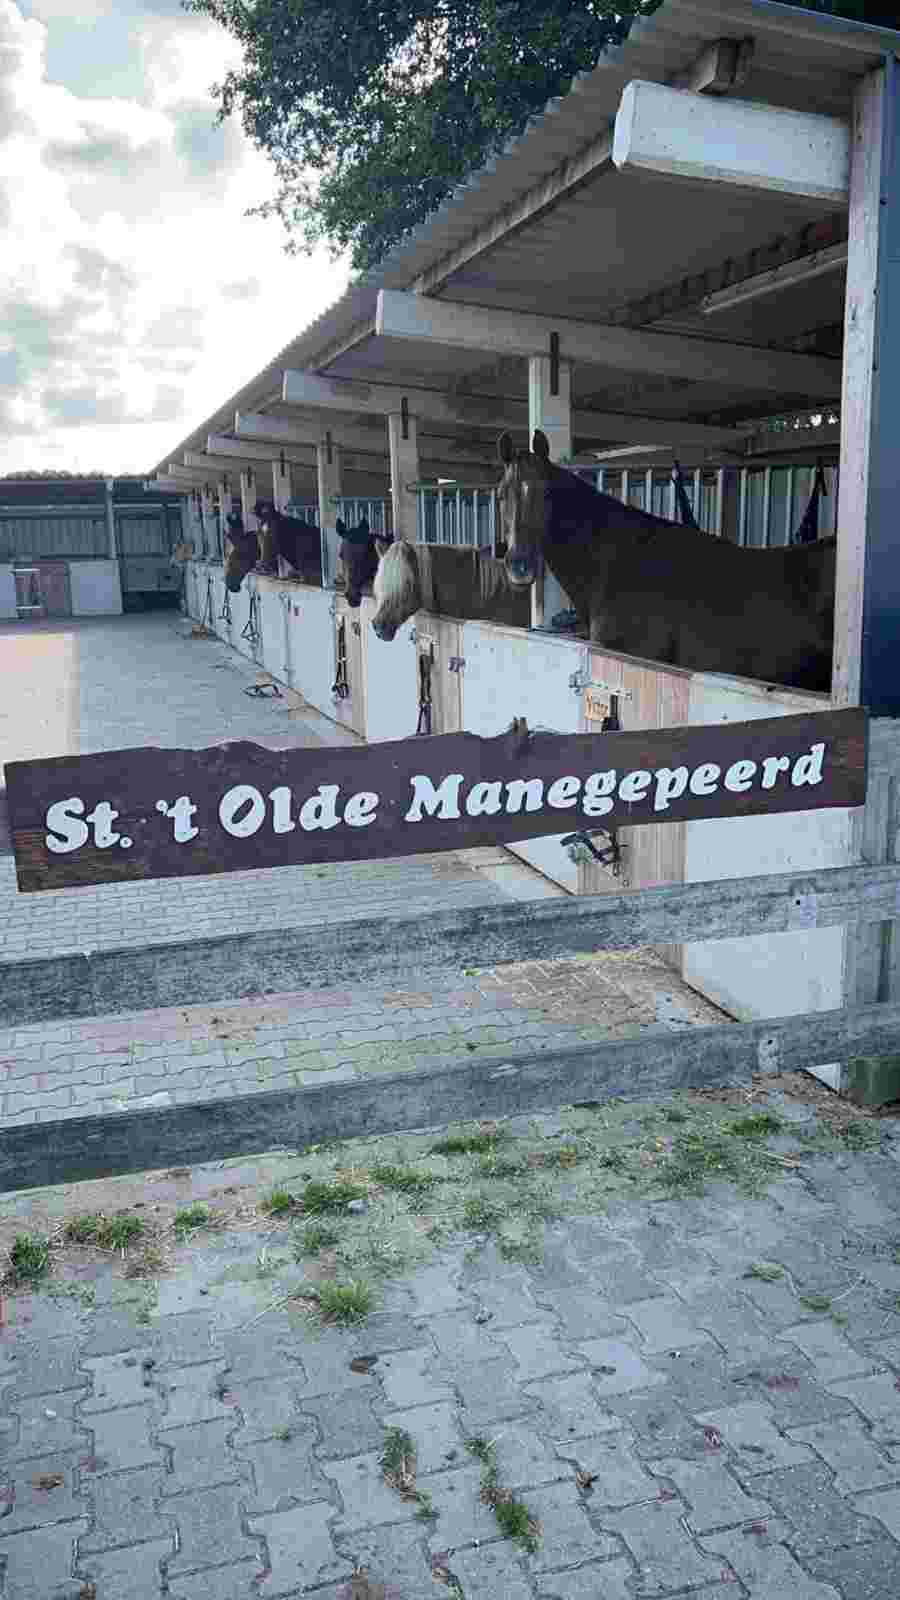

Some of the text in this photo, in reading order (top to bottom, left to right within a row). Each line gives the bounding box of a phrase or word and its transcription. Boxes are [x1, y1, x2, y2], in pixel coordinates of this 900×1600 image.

[46, 797, 133, 853] St.
[219, 784, 379, 837] Olde
[404, 743, 826, 822] Manegepeerd
